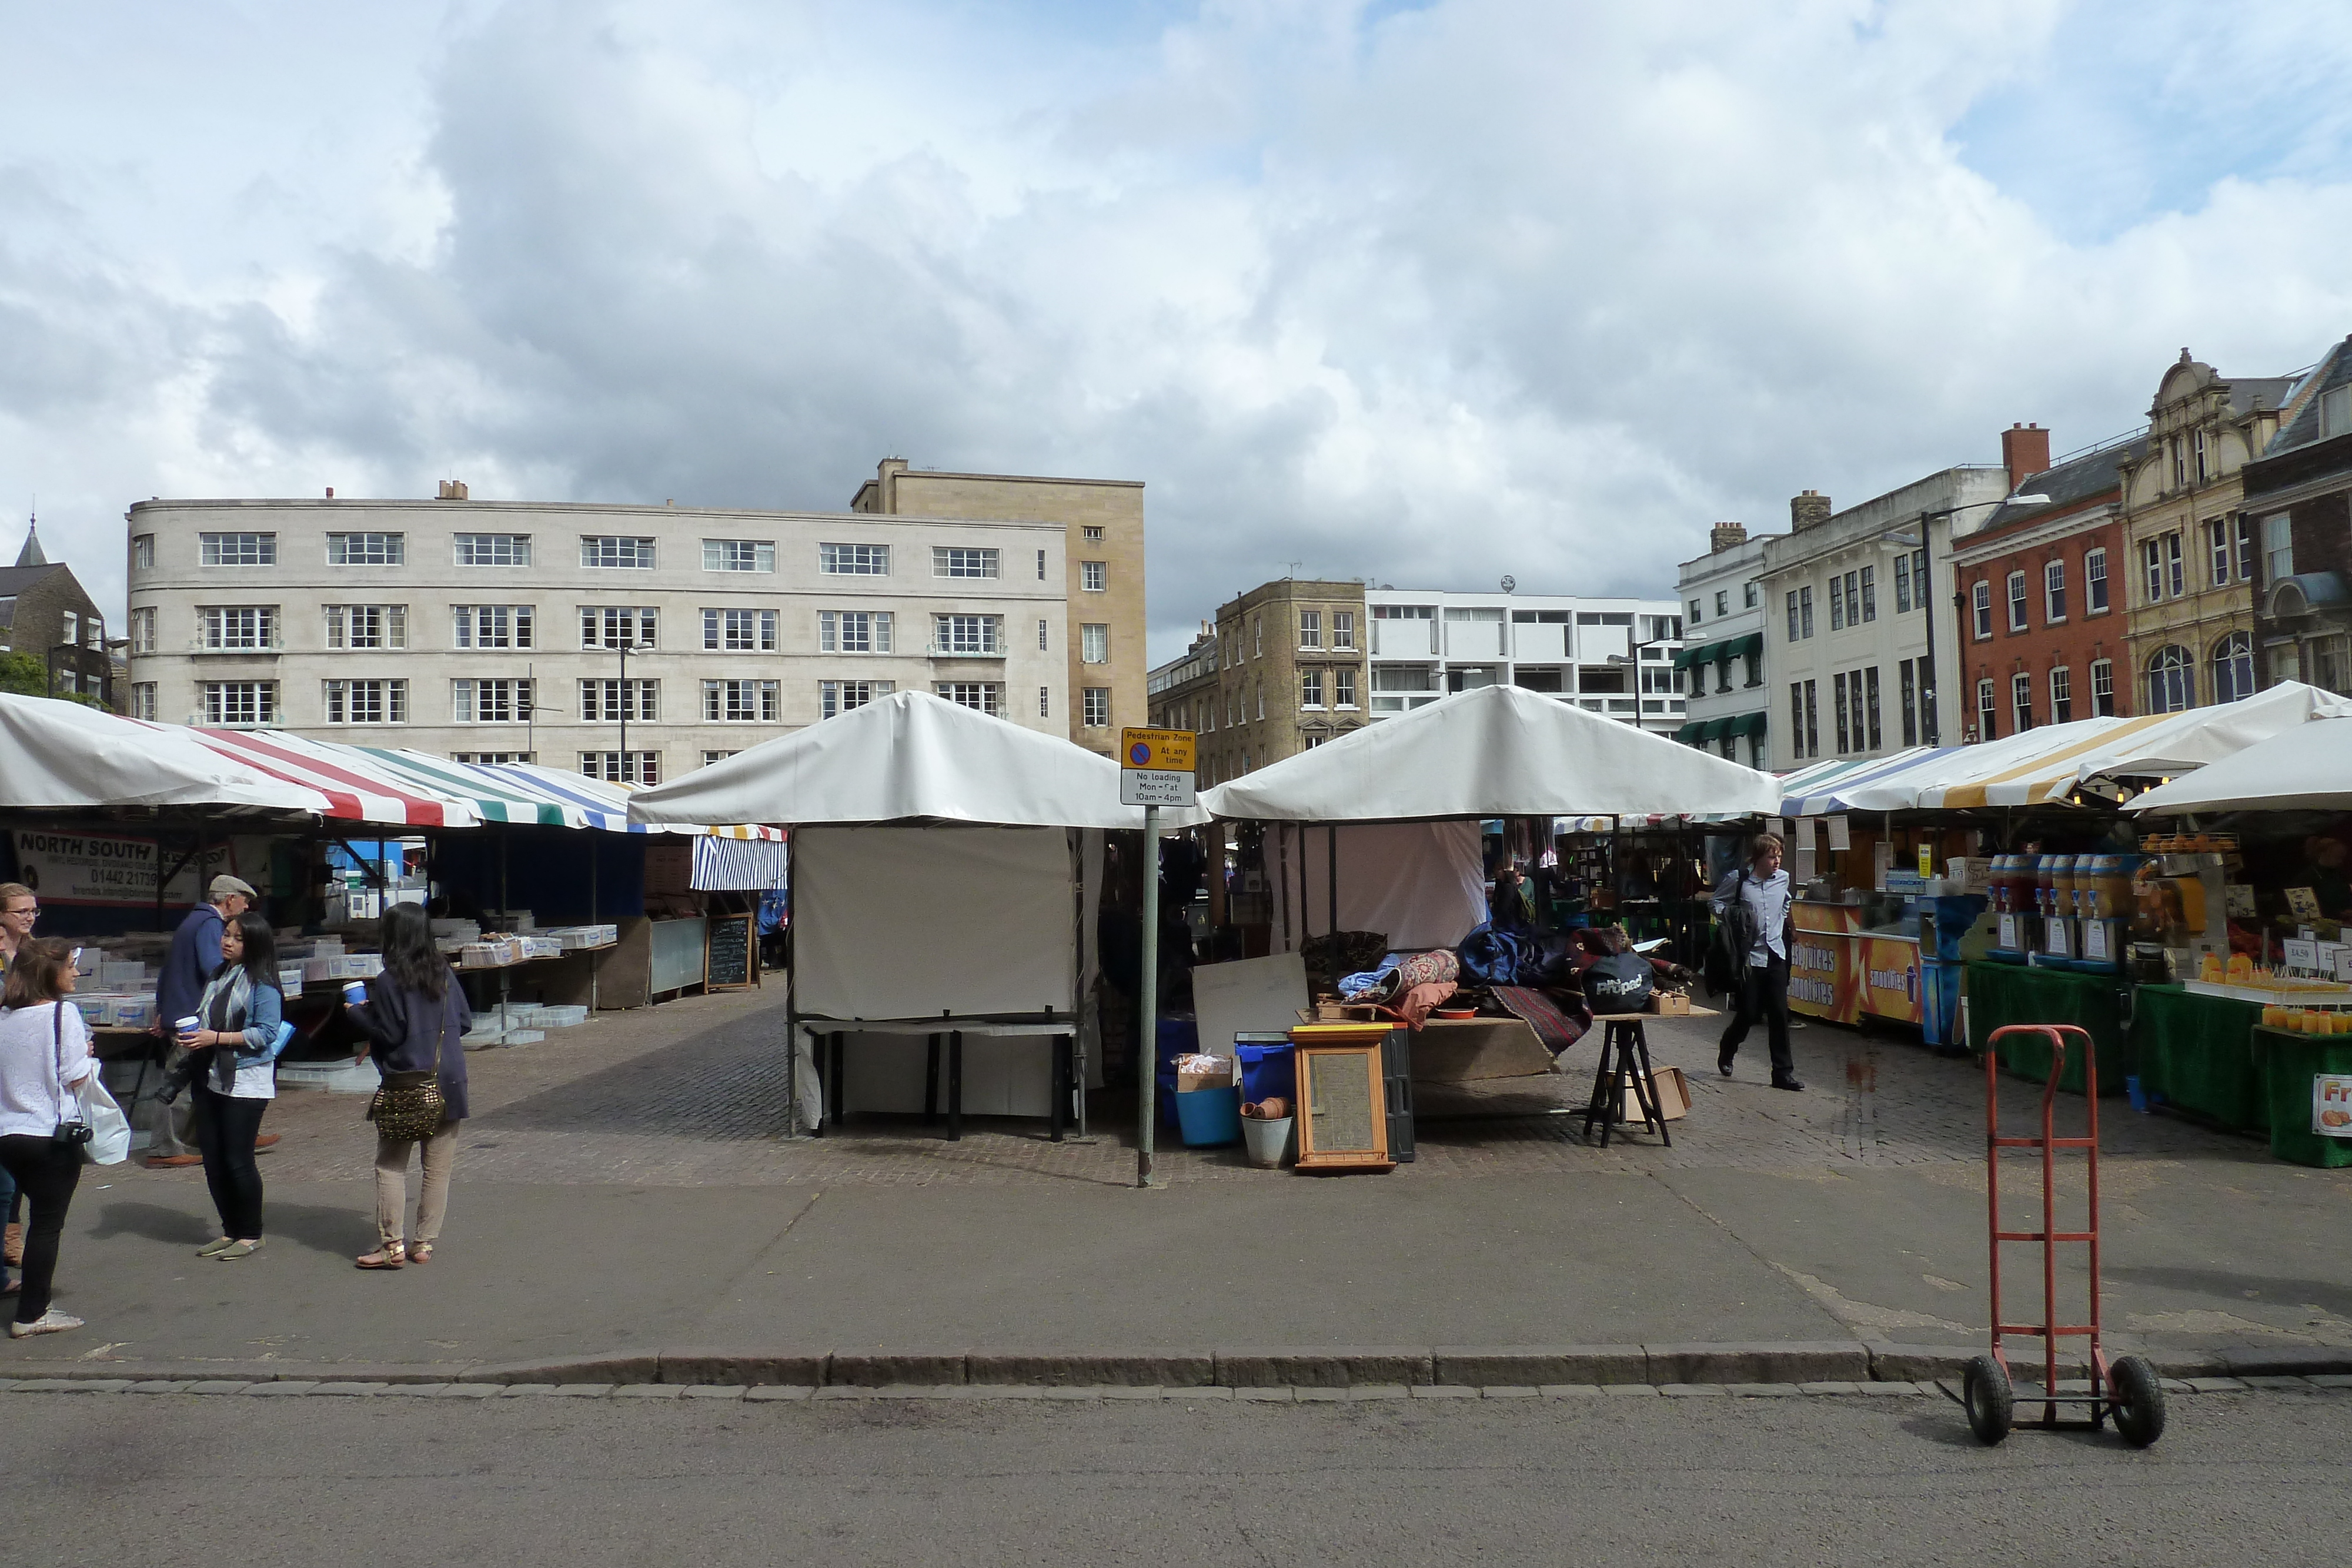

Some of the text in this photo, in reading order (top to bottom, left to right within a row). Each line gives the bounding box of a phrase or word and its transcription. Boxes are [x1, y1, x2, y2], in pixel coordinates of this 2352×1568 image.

[1127, 731, 1170, 740] Pedestrian
[1152, 773, 1181, 783] loading
[1164, 794, 1181, 803] 4pm
[21, 833, 83, 855] NORTH
[88, 840, 152, 860] SOUTH
[91, 869, 123, 884] 01442
[1870, 968, 1906, 992] smoothies
[2324, 1081, 2352, 1102] Fr
